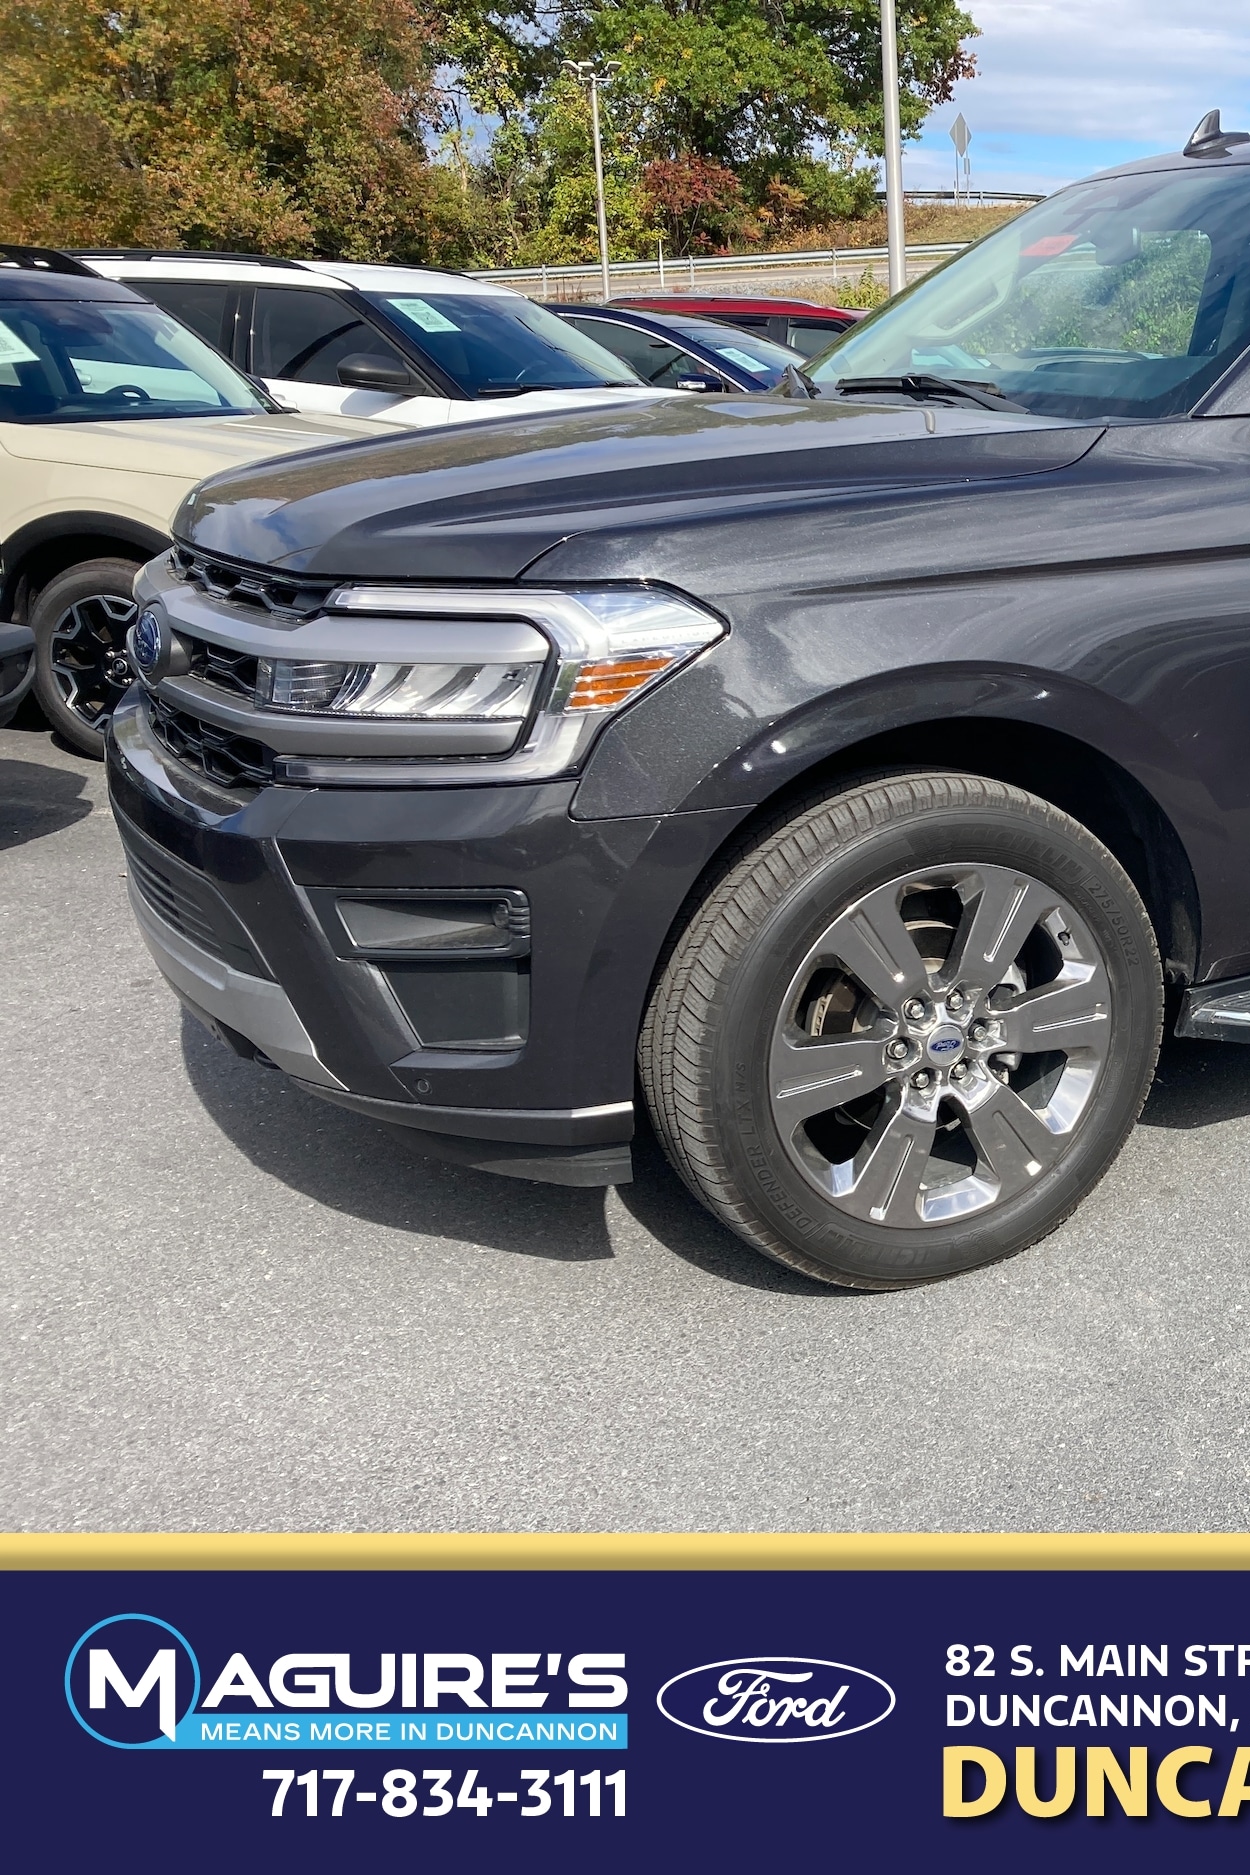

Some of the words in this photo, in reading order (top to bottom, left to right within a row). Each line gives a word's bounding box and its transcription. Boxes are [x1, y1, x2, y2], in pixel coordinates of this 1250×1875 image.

[1087, 882, 1140, 967] 275/50R22
[734, 1062, 747, 1093] M/S
[736, 1099, 756, 1136] LTX
[746, 1144, 812, 1230] DEFENDER
